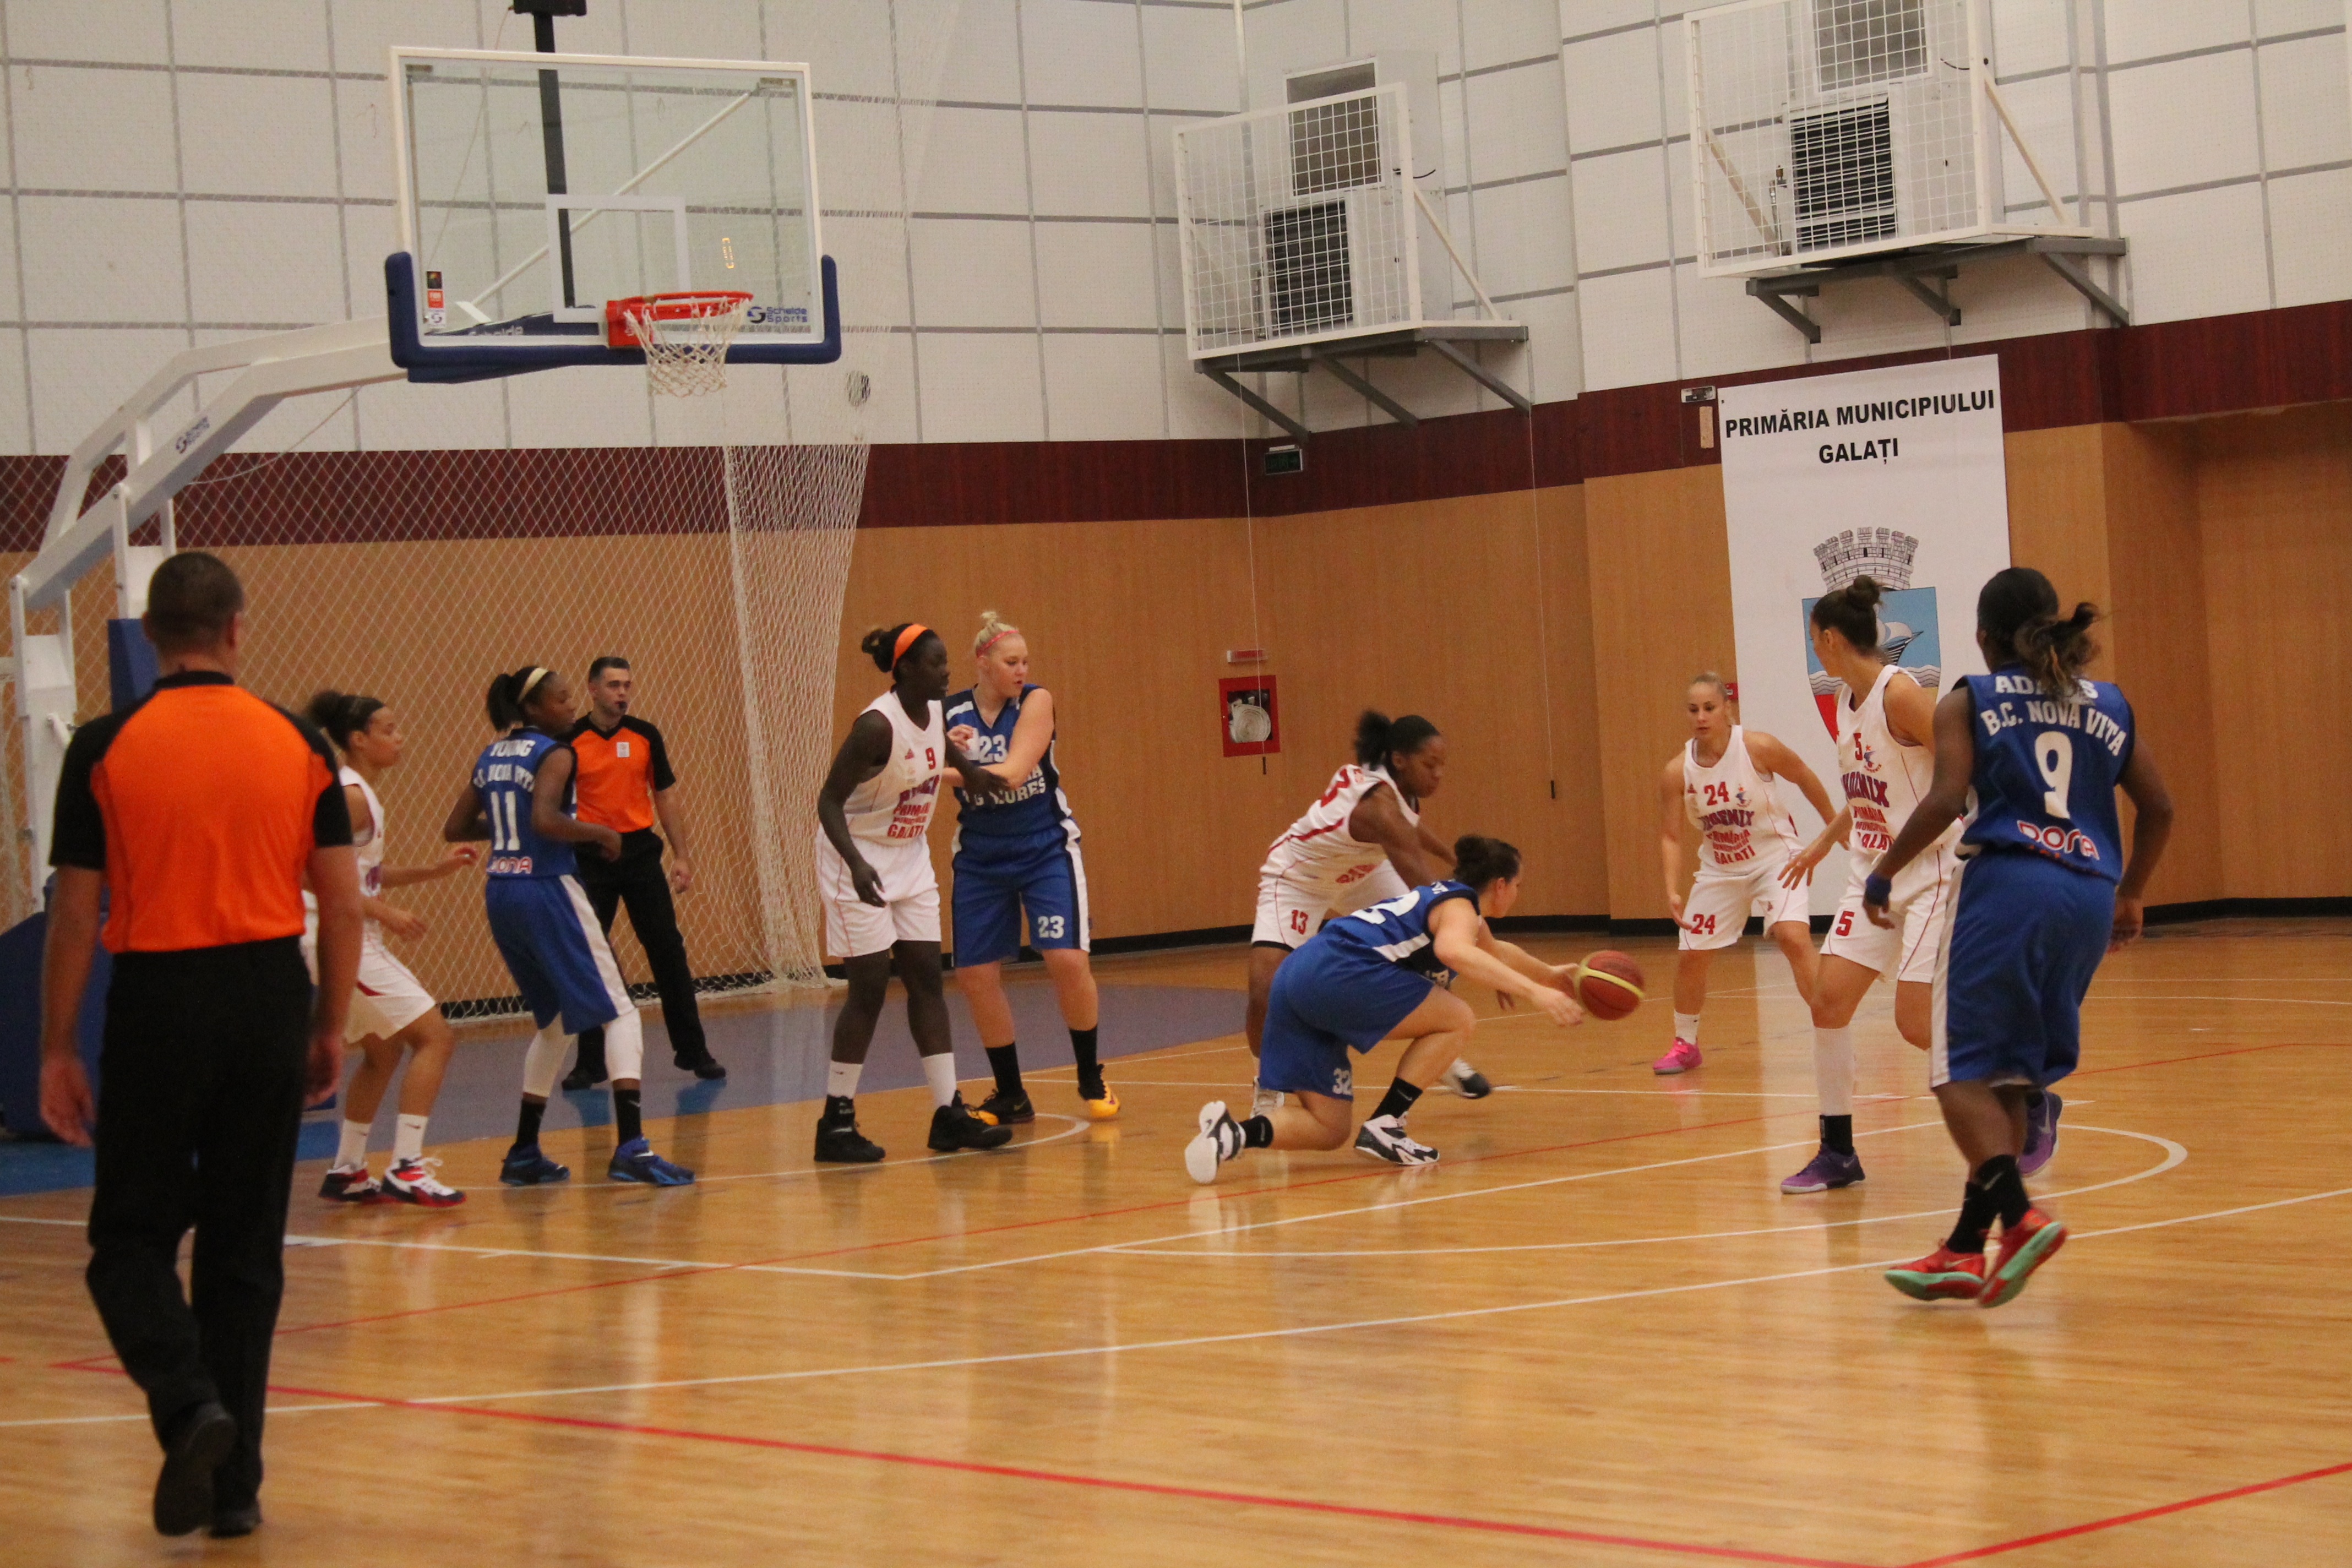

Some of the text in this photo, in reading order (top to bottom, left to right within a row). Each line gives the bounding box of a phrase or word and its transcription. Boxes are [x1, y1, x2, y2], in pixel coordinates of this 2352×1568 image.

[767, 315, 808, 323] Sports
[1726, 390, 1995, 438] PRIMĂRIA MUNICIPIULUI
[1995, 675, 2098, 699] ADS
[2026, 700, 2081, 728] NOVA
[2085, 707, 2127, 756] VITA
[925, 747, 936, 770] 9
[978, 734, 1008, 764] 23
[1853, 733, 1863, 761] 5
[2034, 731, 2073, 819] 9
[1704, 781, 1730, 806] 24
[491, 791, 520, 851] 11
[1038, 915, 1065, 939] 23
[1291, 910, 1309, 935] 13
[1691, 913, 1716, 935] 24
[1835, 911, 1855, 937] 5
[1332, 1068, 1352, 1096] 32
